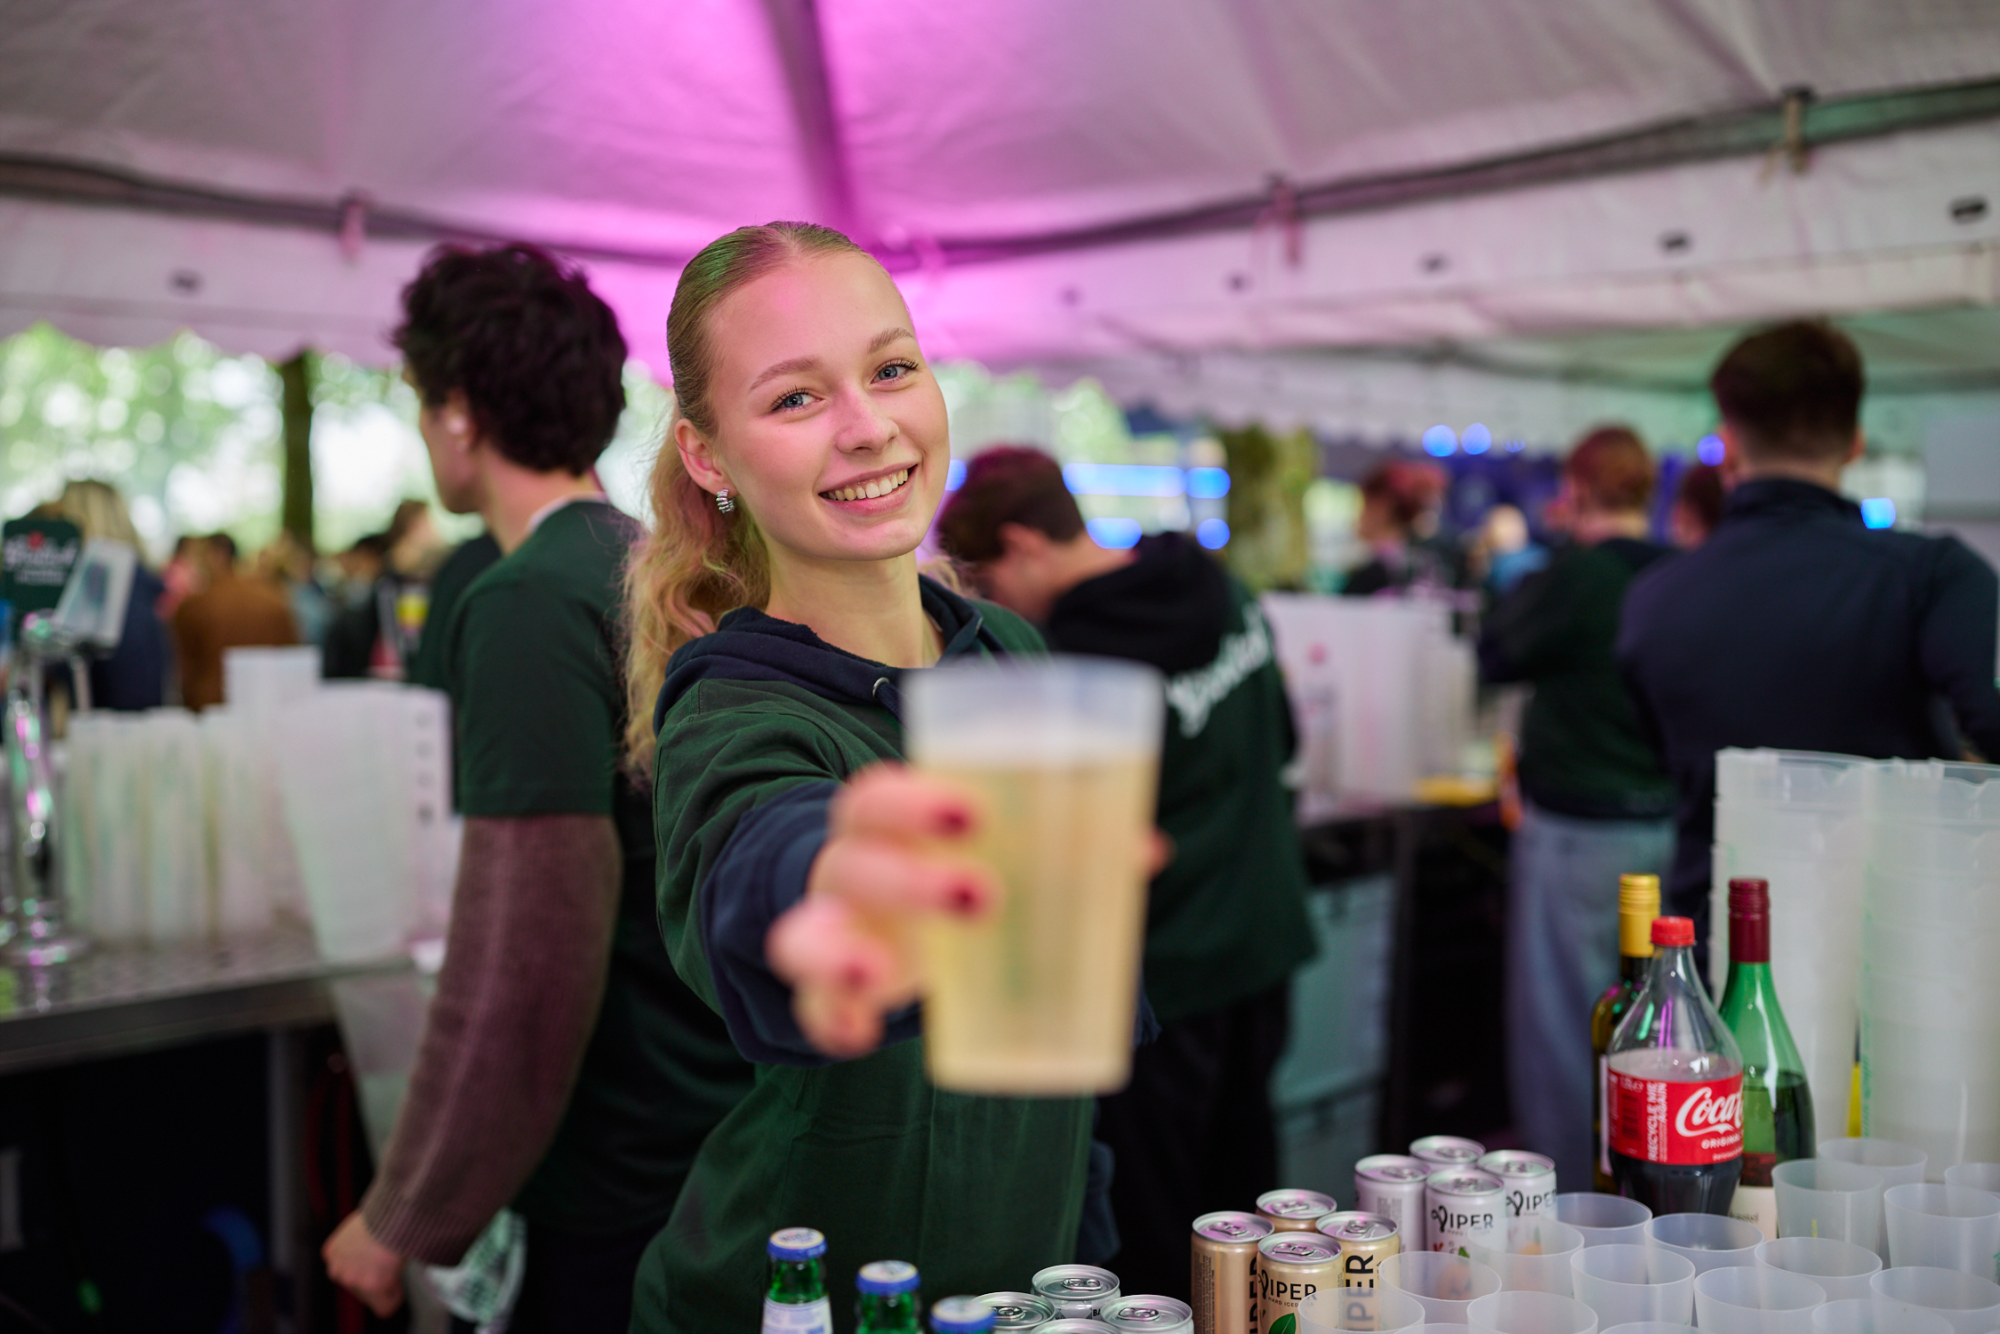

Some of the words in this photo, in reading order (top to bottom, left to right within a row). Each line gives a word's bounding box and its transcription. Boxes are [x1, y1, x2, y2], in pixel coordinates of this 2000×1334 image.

[1646, 1082, 1658, 1103] ME
[1657, 1082, 1667, 1123] AGAIN
[1647, 1105, 1659, 1161] RECYCLE
[1431, 1205, 1494, 1234] VIPER
[1258, 1269, 1317, 1301] VIPER
[1268, 1296, 1283, 1306] HARD
